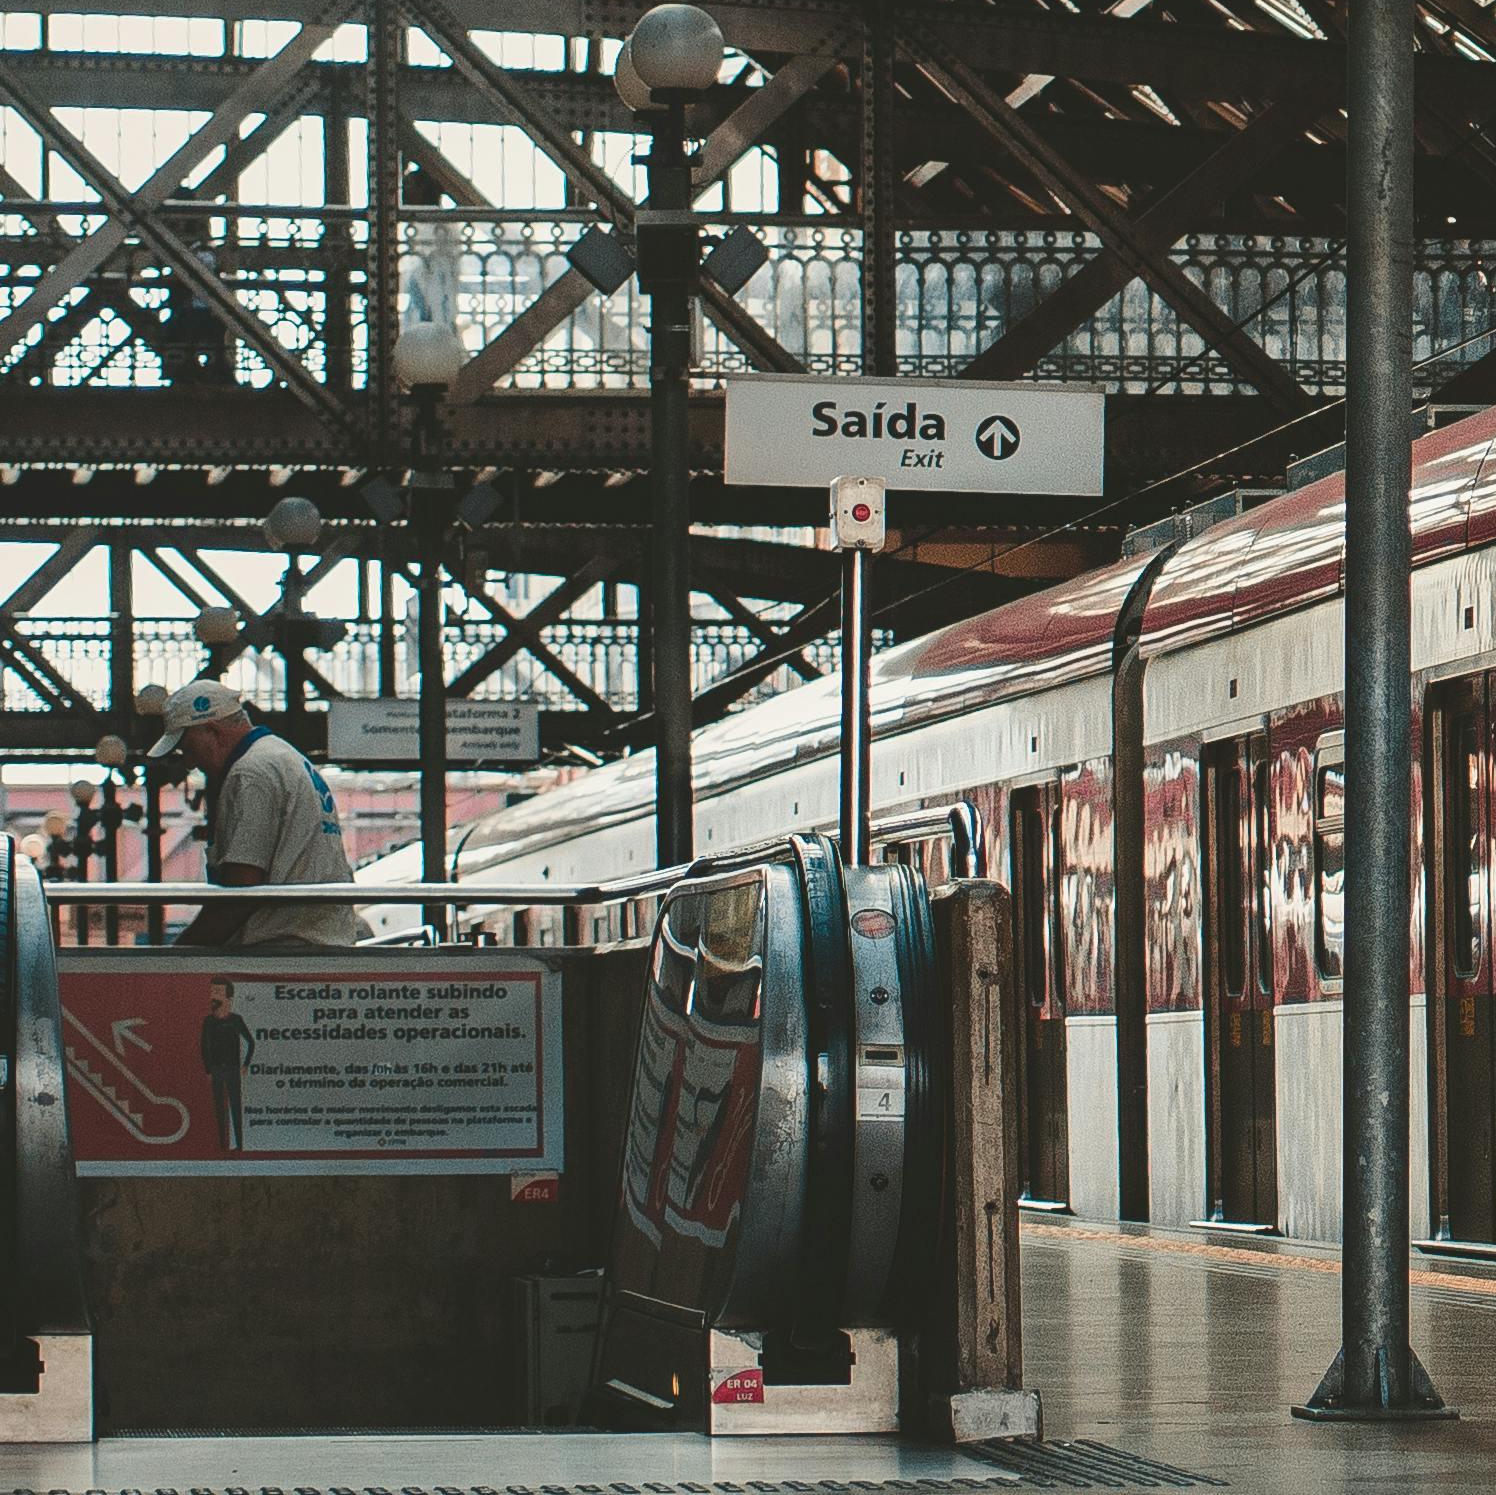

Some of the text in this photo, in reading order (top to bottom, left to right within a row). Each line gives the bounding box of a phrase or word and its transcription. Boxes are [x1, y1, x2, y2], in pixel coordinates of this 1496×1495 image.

[812, 401, 946, 441] Saída
[900, 448, 945, 469] Exit
[447, 708, 508, 719] ataforma
[274, 983, 508, 1000] Escada rolante subindo
[313, 1004, 470, 1024] para atender as
[255, 1022, 527, 1043] necessidades operacionais.
[250, 1063, 341, 1076] Diariamente,
[345, 1063, 369, 1075] das
[414, 1062, 438, 1074] 16h
[442, 1064, 450, 1074] e
[454, 1062, 478, 1074] das
[481, 1062, 507, 1074] 21h
[511, 1061, 533, 1074] até
[275, 1075, 509, 1091] o término da operação comercial.
[878, 1092, 892, 1112] 4
[524, 1187, 549, 1200] ER4
[726, 1379, 757, 1389] ER 04
[736, 1393, 753, 1401] LUZ
